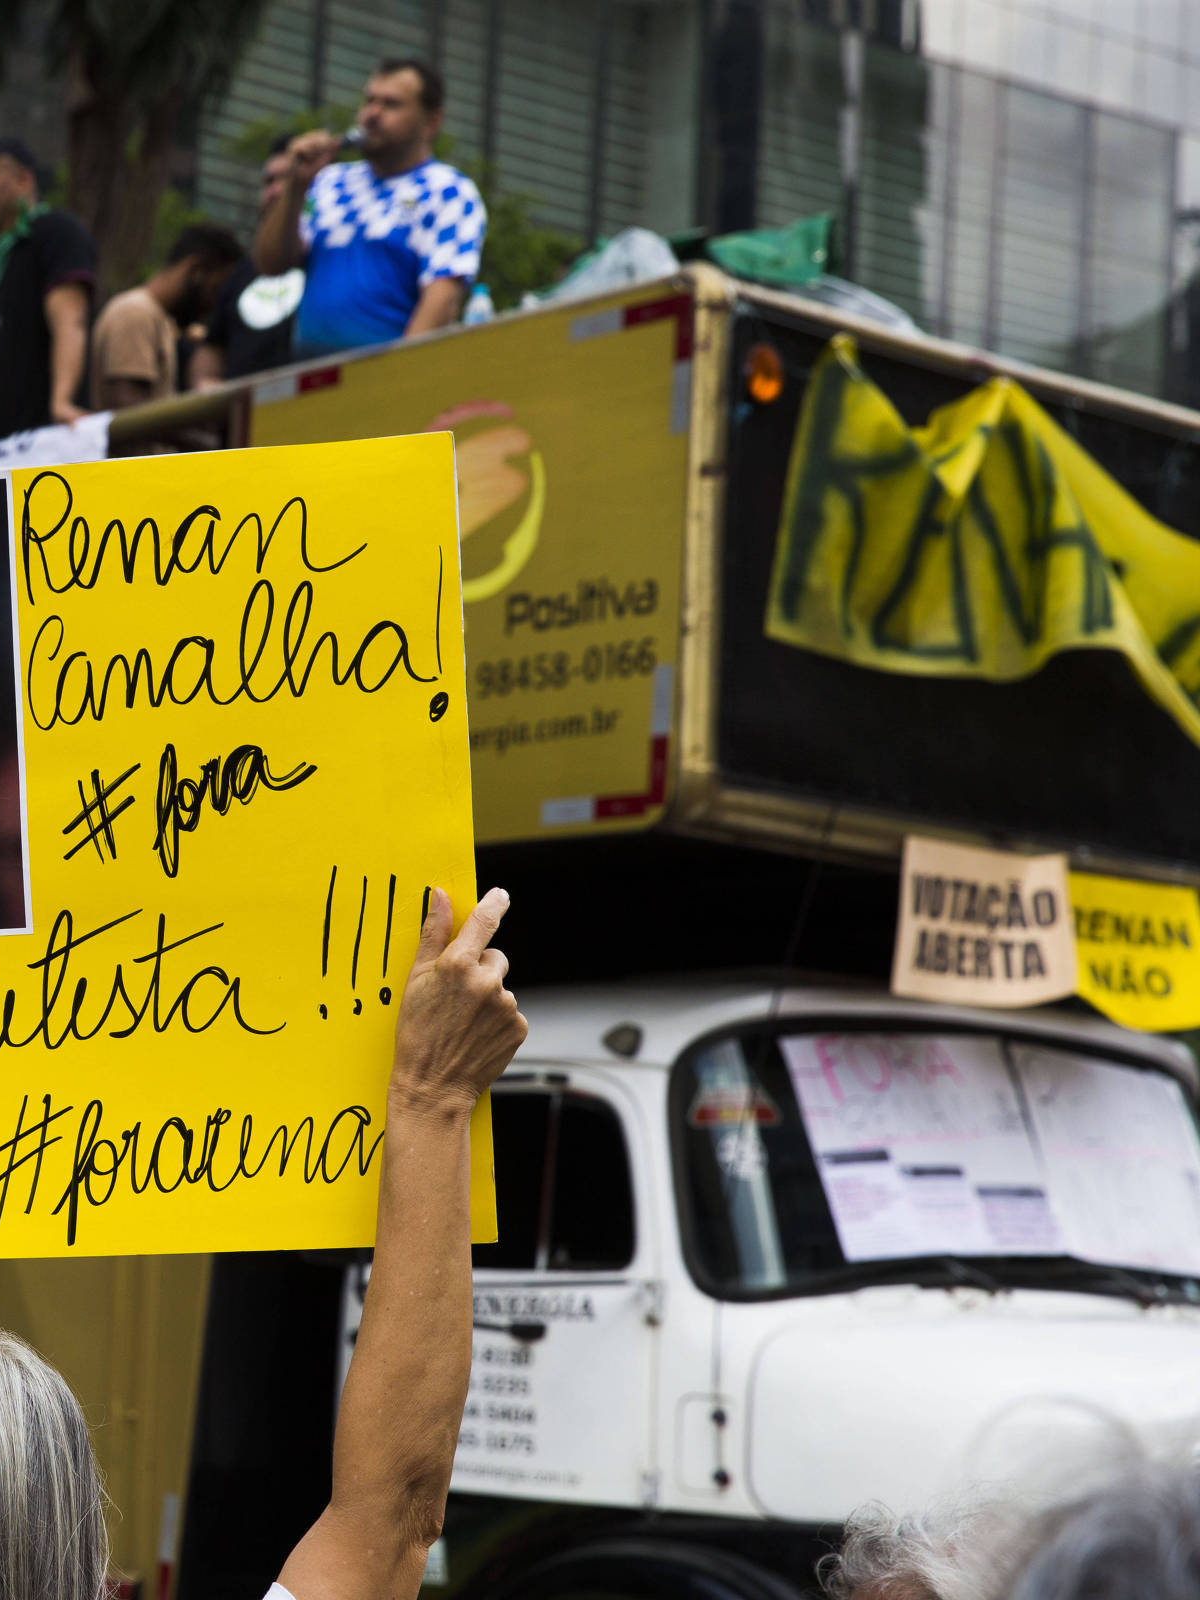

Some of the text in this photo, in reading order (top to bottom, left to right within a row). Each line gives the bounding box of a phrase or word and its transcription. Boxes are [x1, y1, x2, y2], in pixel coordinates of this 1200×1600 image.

[22, 471, 369, 605] Renan
[504, 576, 659, 636] Positiva
[912, 872, 1057, 930] VOTAÇÃO
[913, 928, 1047, 980] ABERTA
